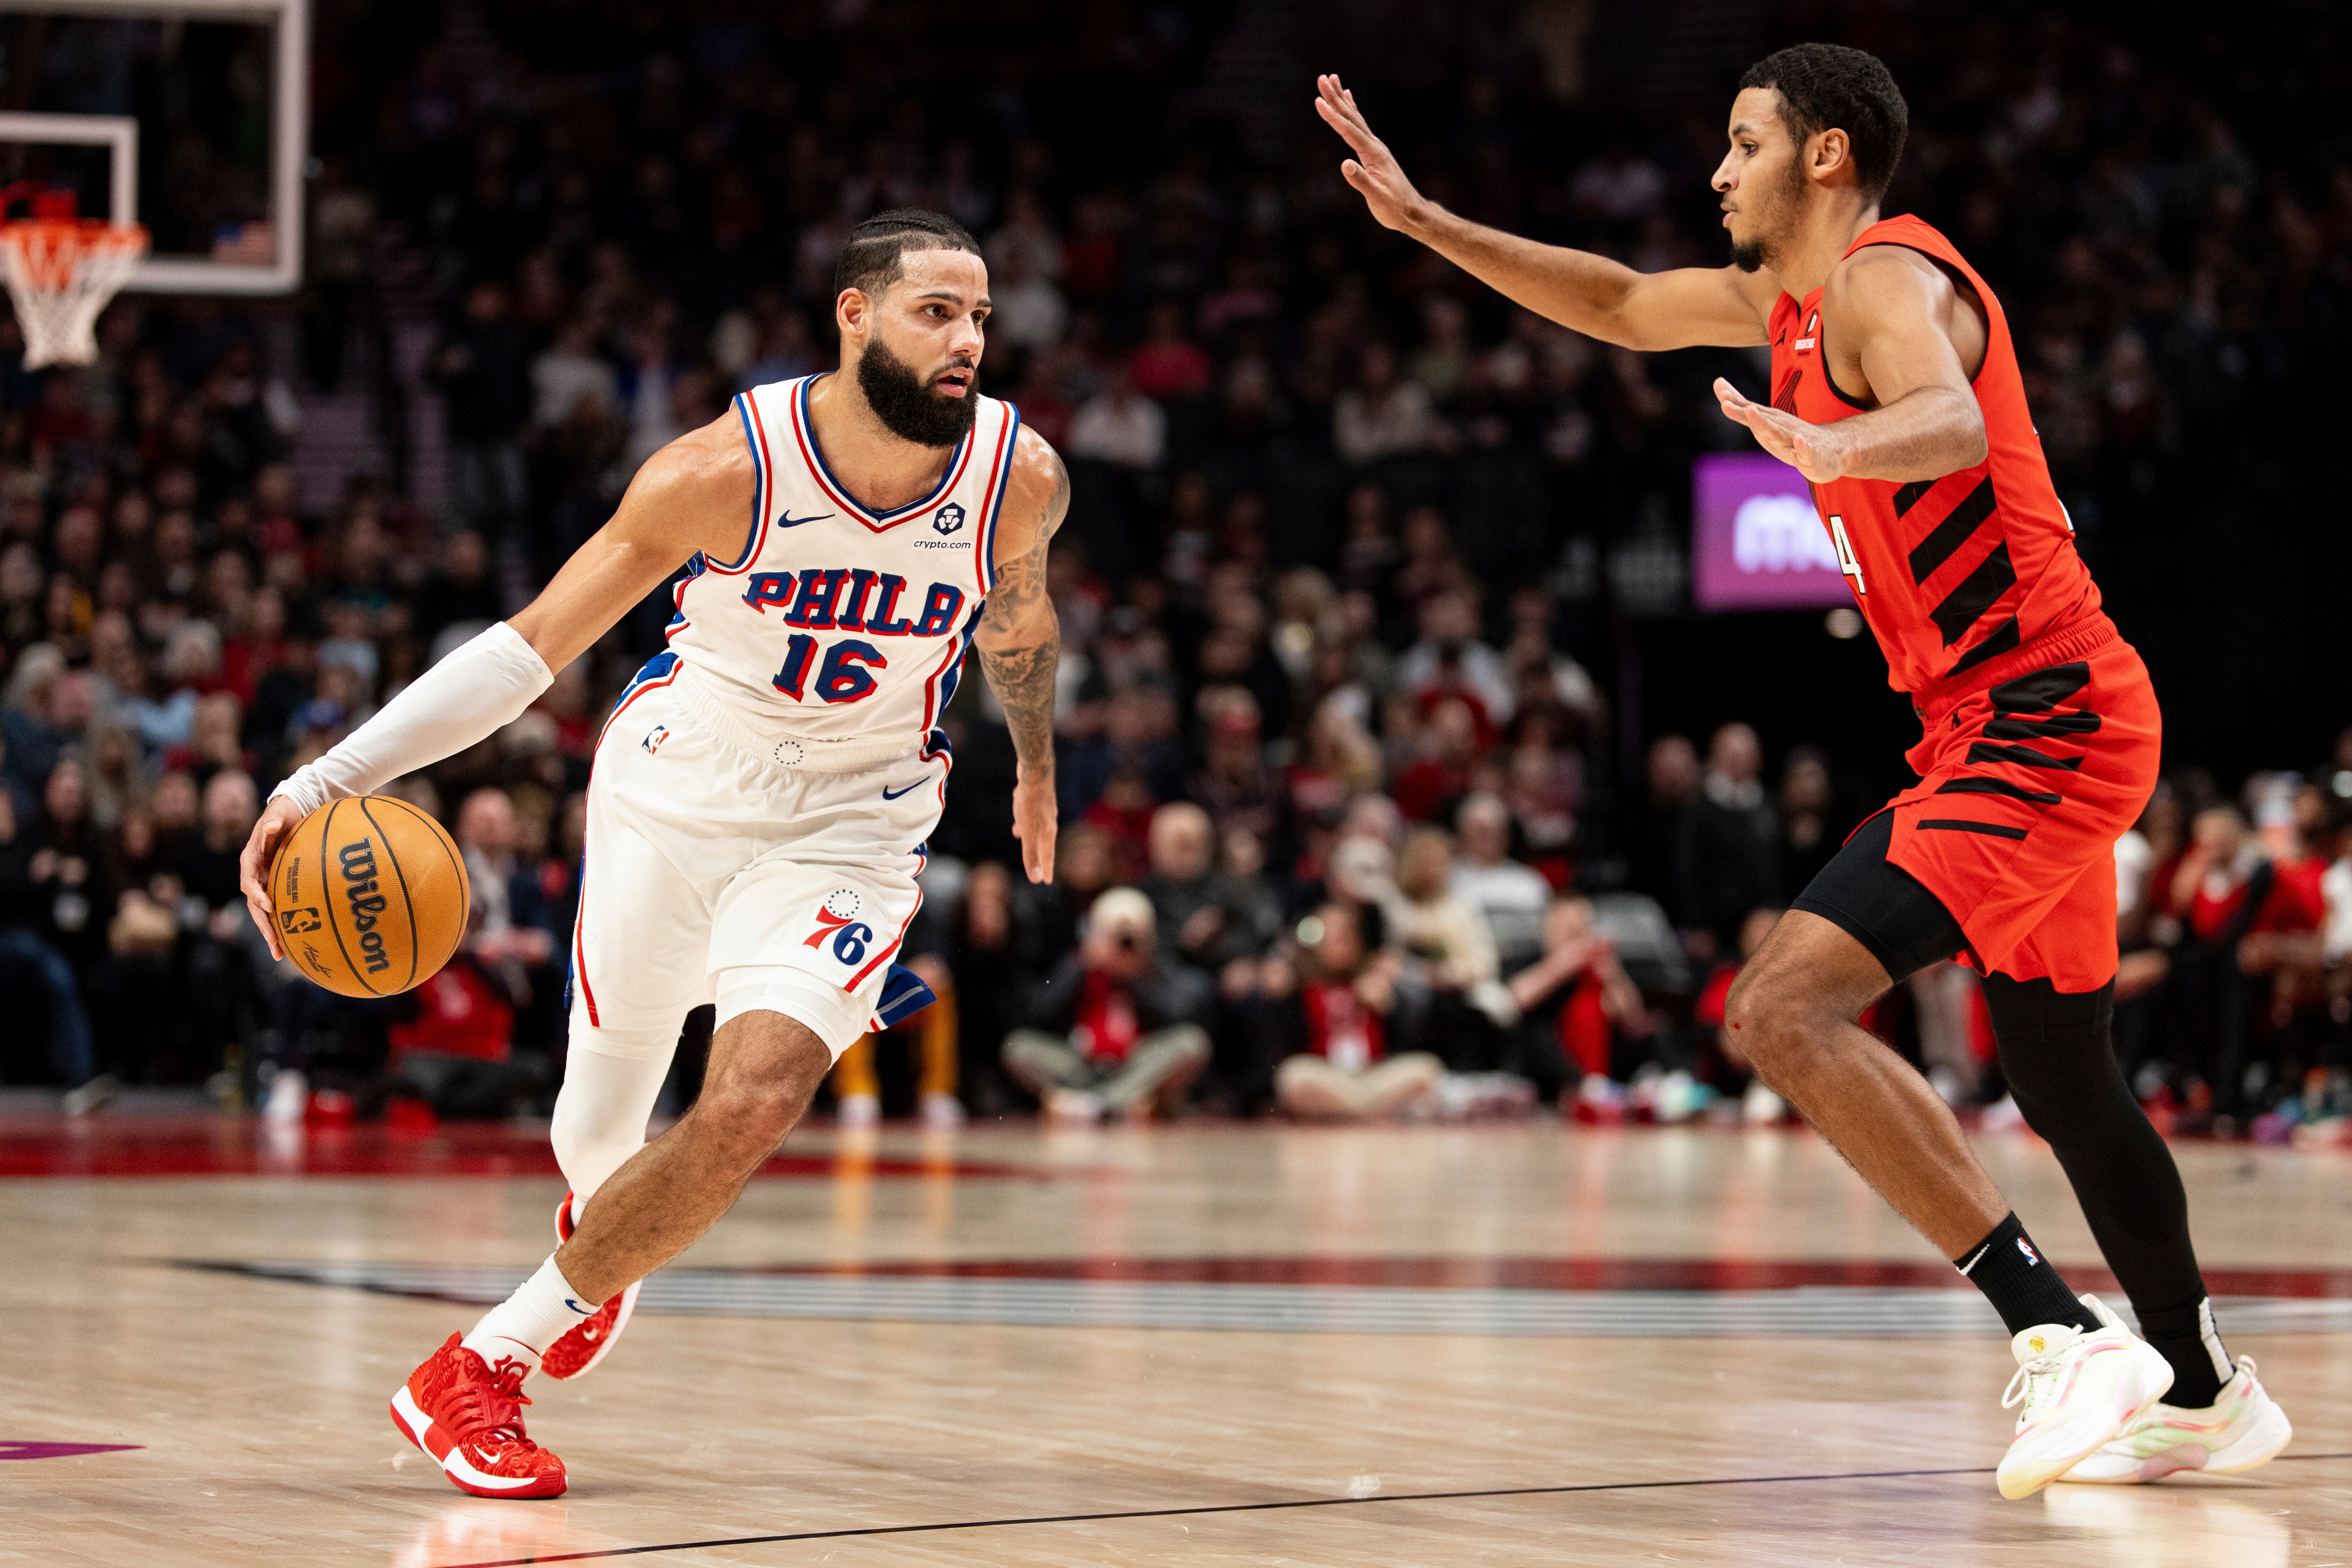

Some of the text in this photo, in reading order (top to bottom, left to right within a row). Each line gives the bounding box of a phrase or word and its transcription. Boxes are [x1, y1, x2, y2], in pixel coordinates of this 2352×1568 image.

[914, 541, 971, 549] crypto.com
[1829, 514, 1866, 595] 4
[742, 568, 965, 637] PHILA
[772, 634, 888, 703] 16
[338, 836, 390, 974] Wilson
[802, 905, 873, 965] 76
